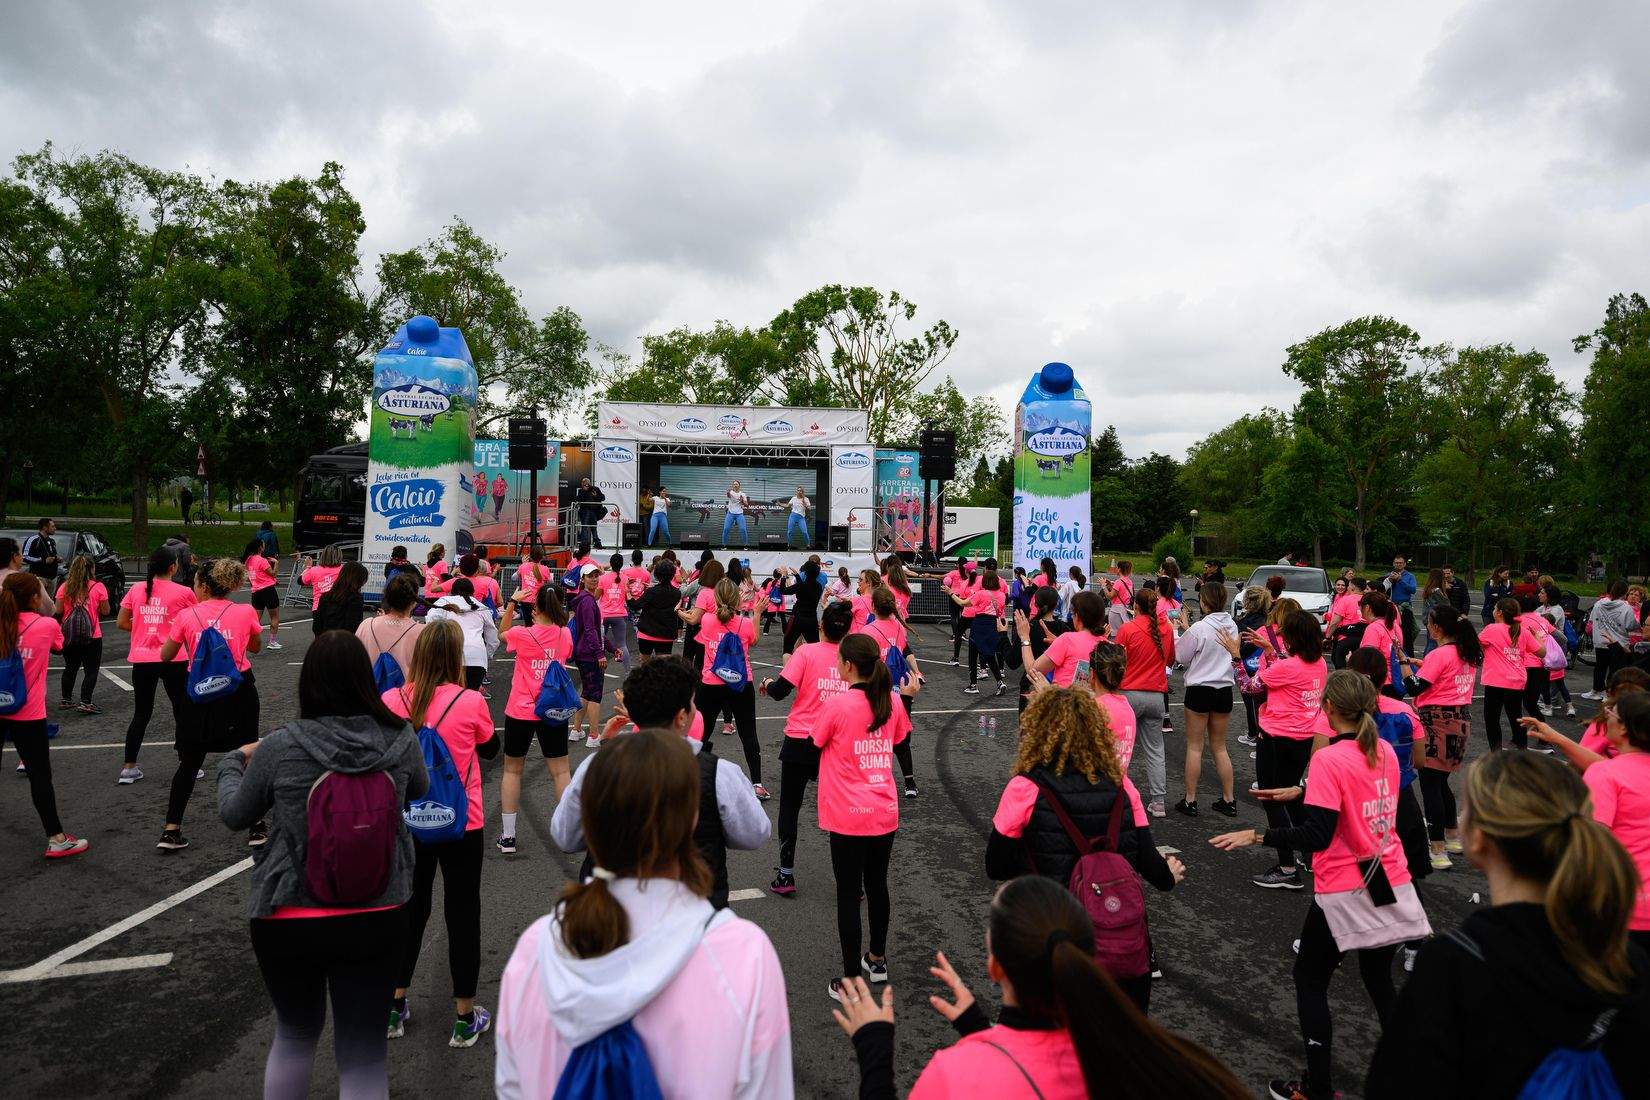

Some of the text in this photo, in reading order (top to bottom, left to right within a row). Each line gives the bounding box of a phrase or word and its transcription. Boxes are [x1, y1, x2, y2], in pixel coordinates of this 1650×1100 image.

[381, 395, 445, 410] ASTURIANA
[638, 420, 667, 428] OYSHO
[836, 425, 864, 433] OYSHO
[1030, 437, 1083, 449] ASTURIANA
[601, 452, 632, 460] ASTURIANA
[838, 458, 868, 466] ASTURIANA
[375, 485, 436, 512] Calcio
[399, 513, 433, 525] natural
[1028, 506, 1060, 525] Leche
[374, 533, 431, 544] semidesnatada
[1026, 522, 1084, 545] semi
[1026, 544, 1085, 560] desnatada
[140, 606, 168, 615] DORSAL
[143, 615, 164, 624] SUMA
[859, 754, 891, 769] SUMA
